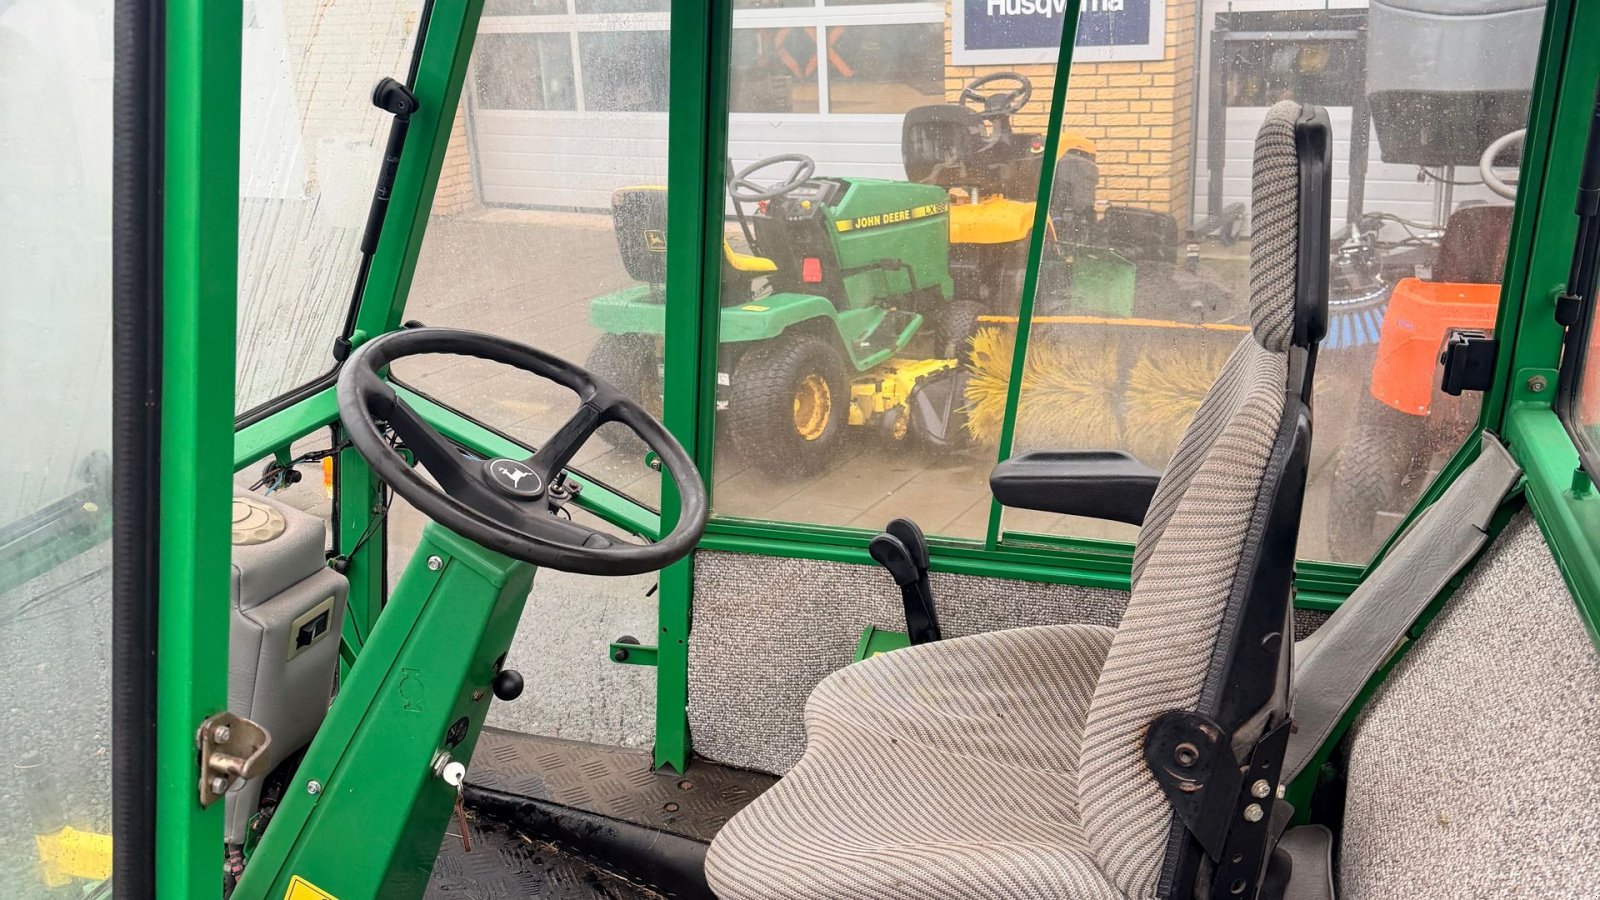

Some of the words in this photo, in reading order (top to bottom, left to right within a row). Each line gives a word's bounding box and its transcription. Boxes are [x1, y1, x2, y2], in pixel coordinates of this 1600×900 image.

[987, 0, 1124, 18] Husqvrna
[855, 215, 881, 229] JOHN
[882, 209, 911, 224] DEERE
